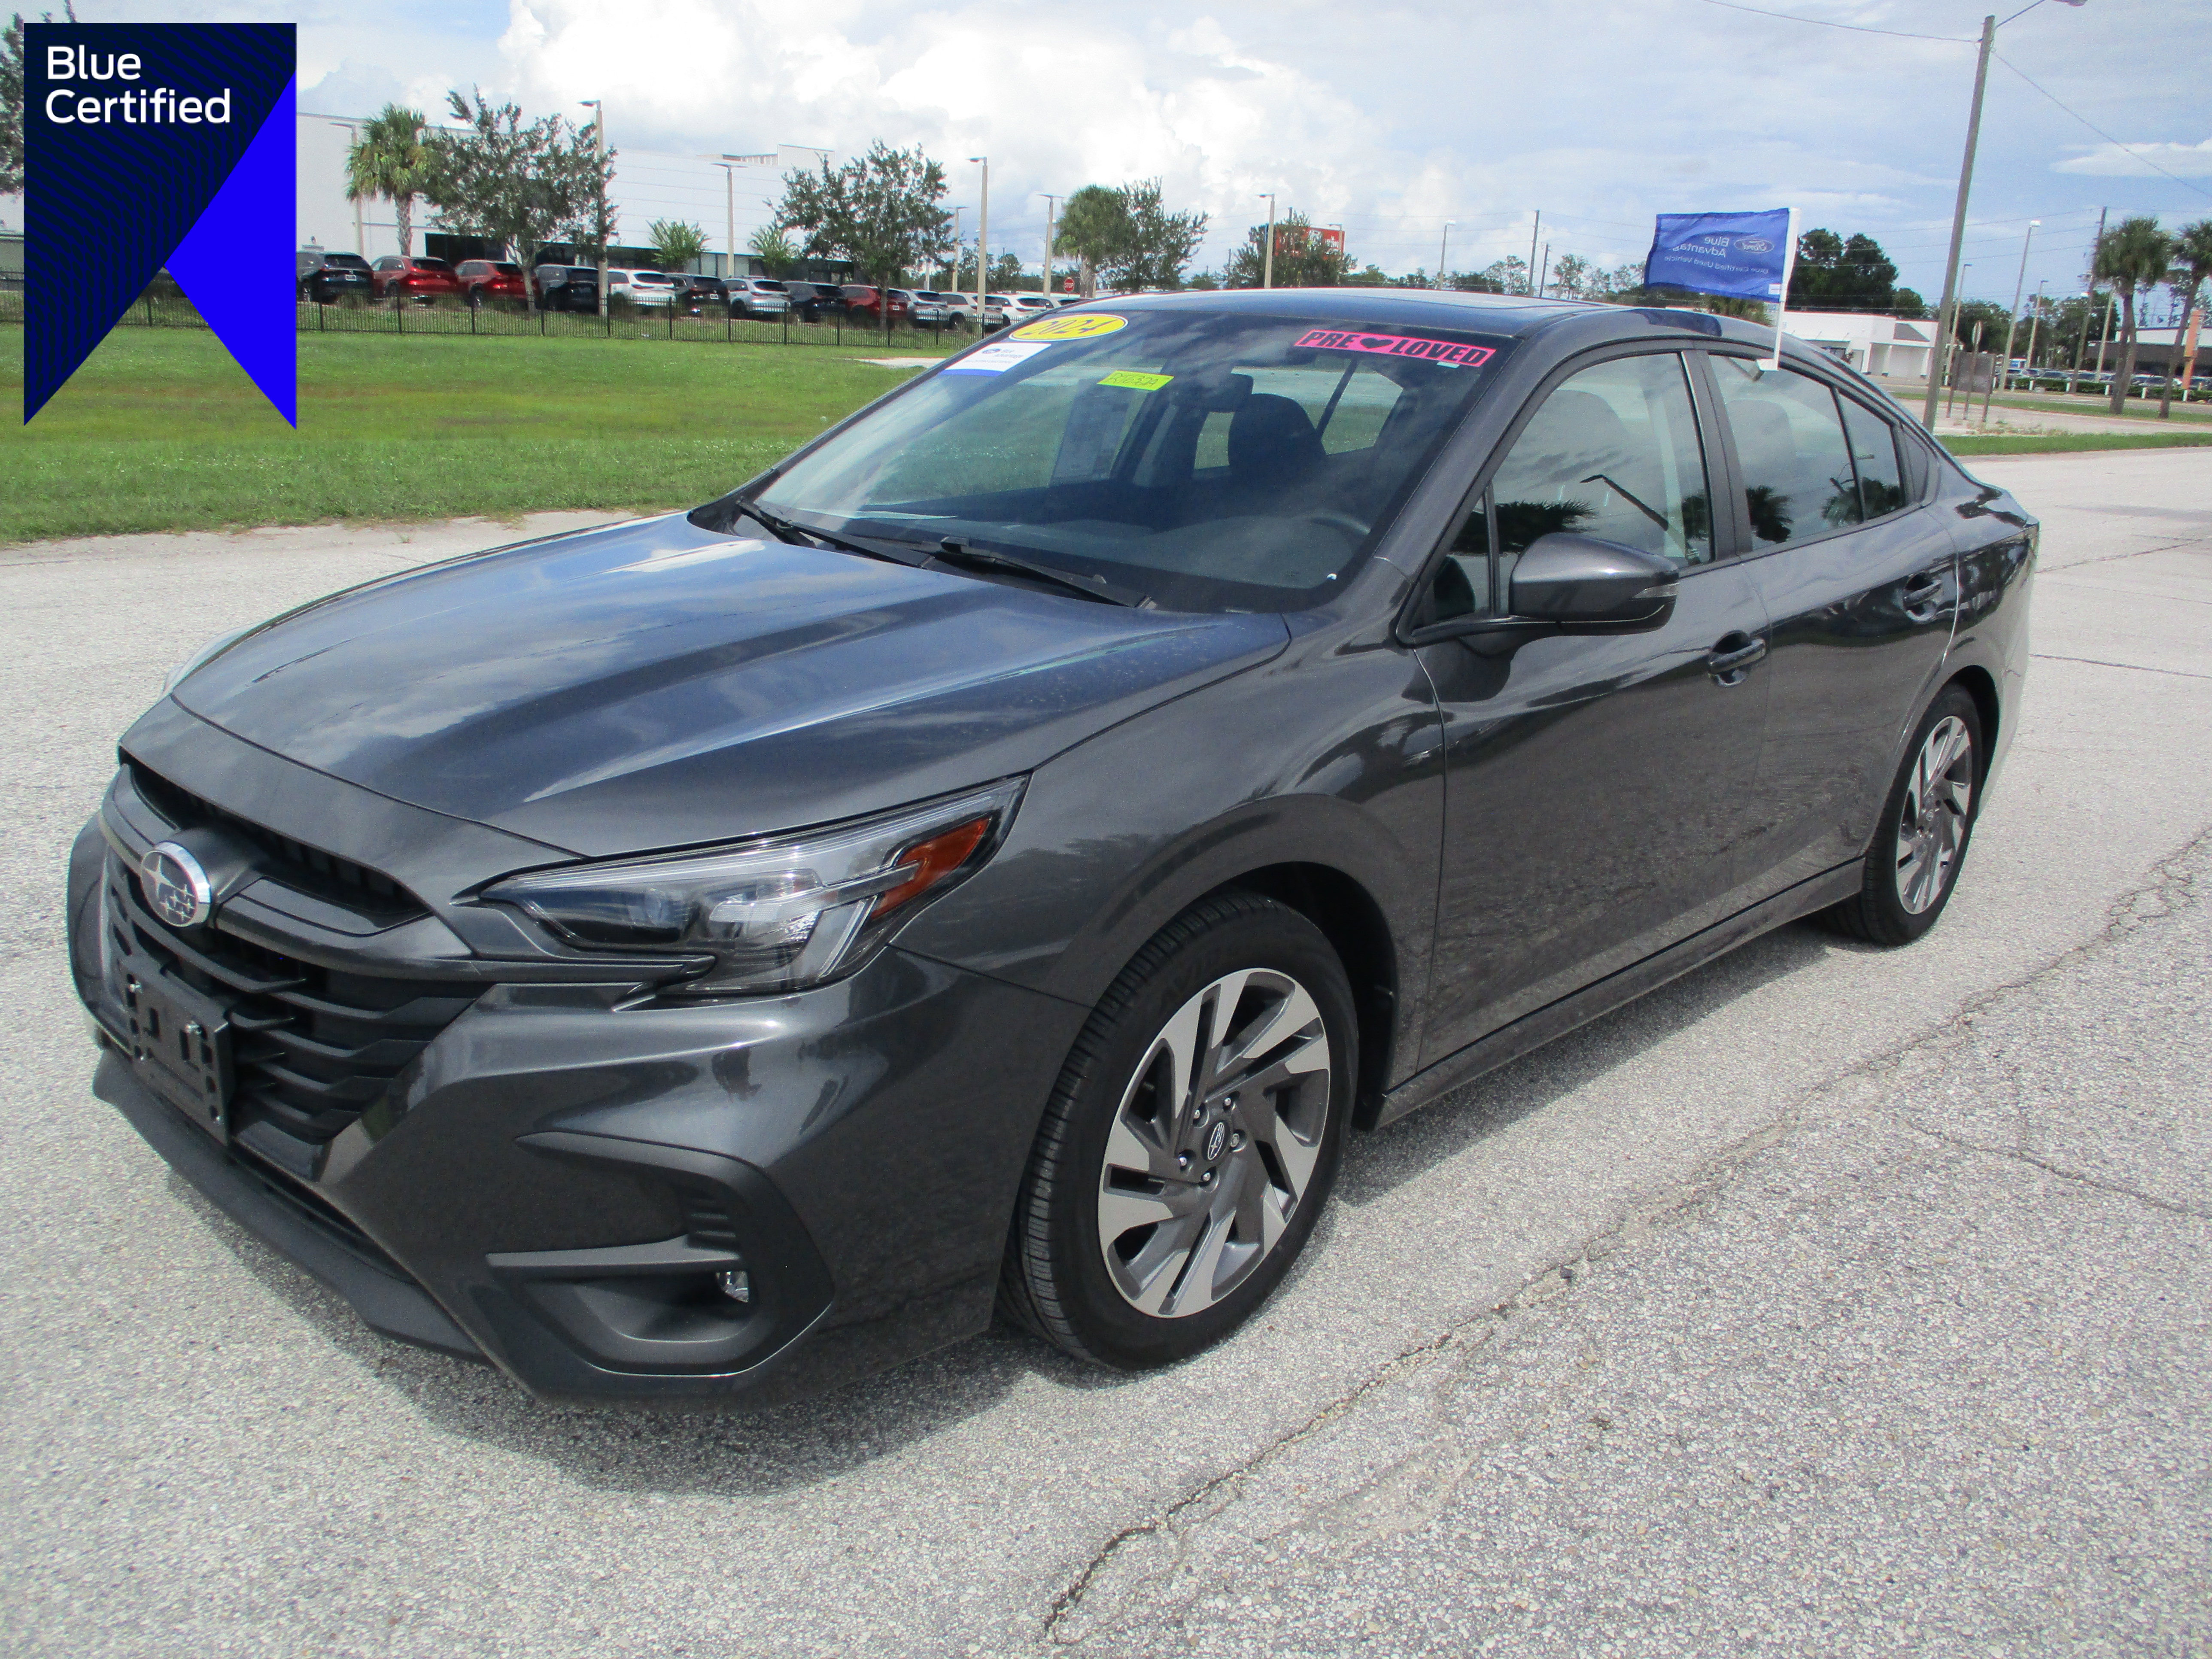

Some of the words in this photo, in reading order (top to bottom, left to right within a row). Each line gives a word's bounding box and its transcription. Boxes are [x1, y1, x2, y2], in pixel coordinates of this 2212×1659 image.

[1020, 319, 1118, 335] 2024
[1299, 331, 1361, 347] PRE
[1389, 339, 1488, 364] LOVED
